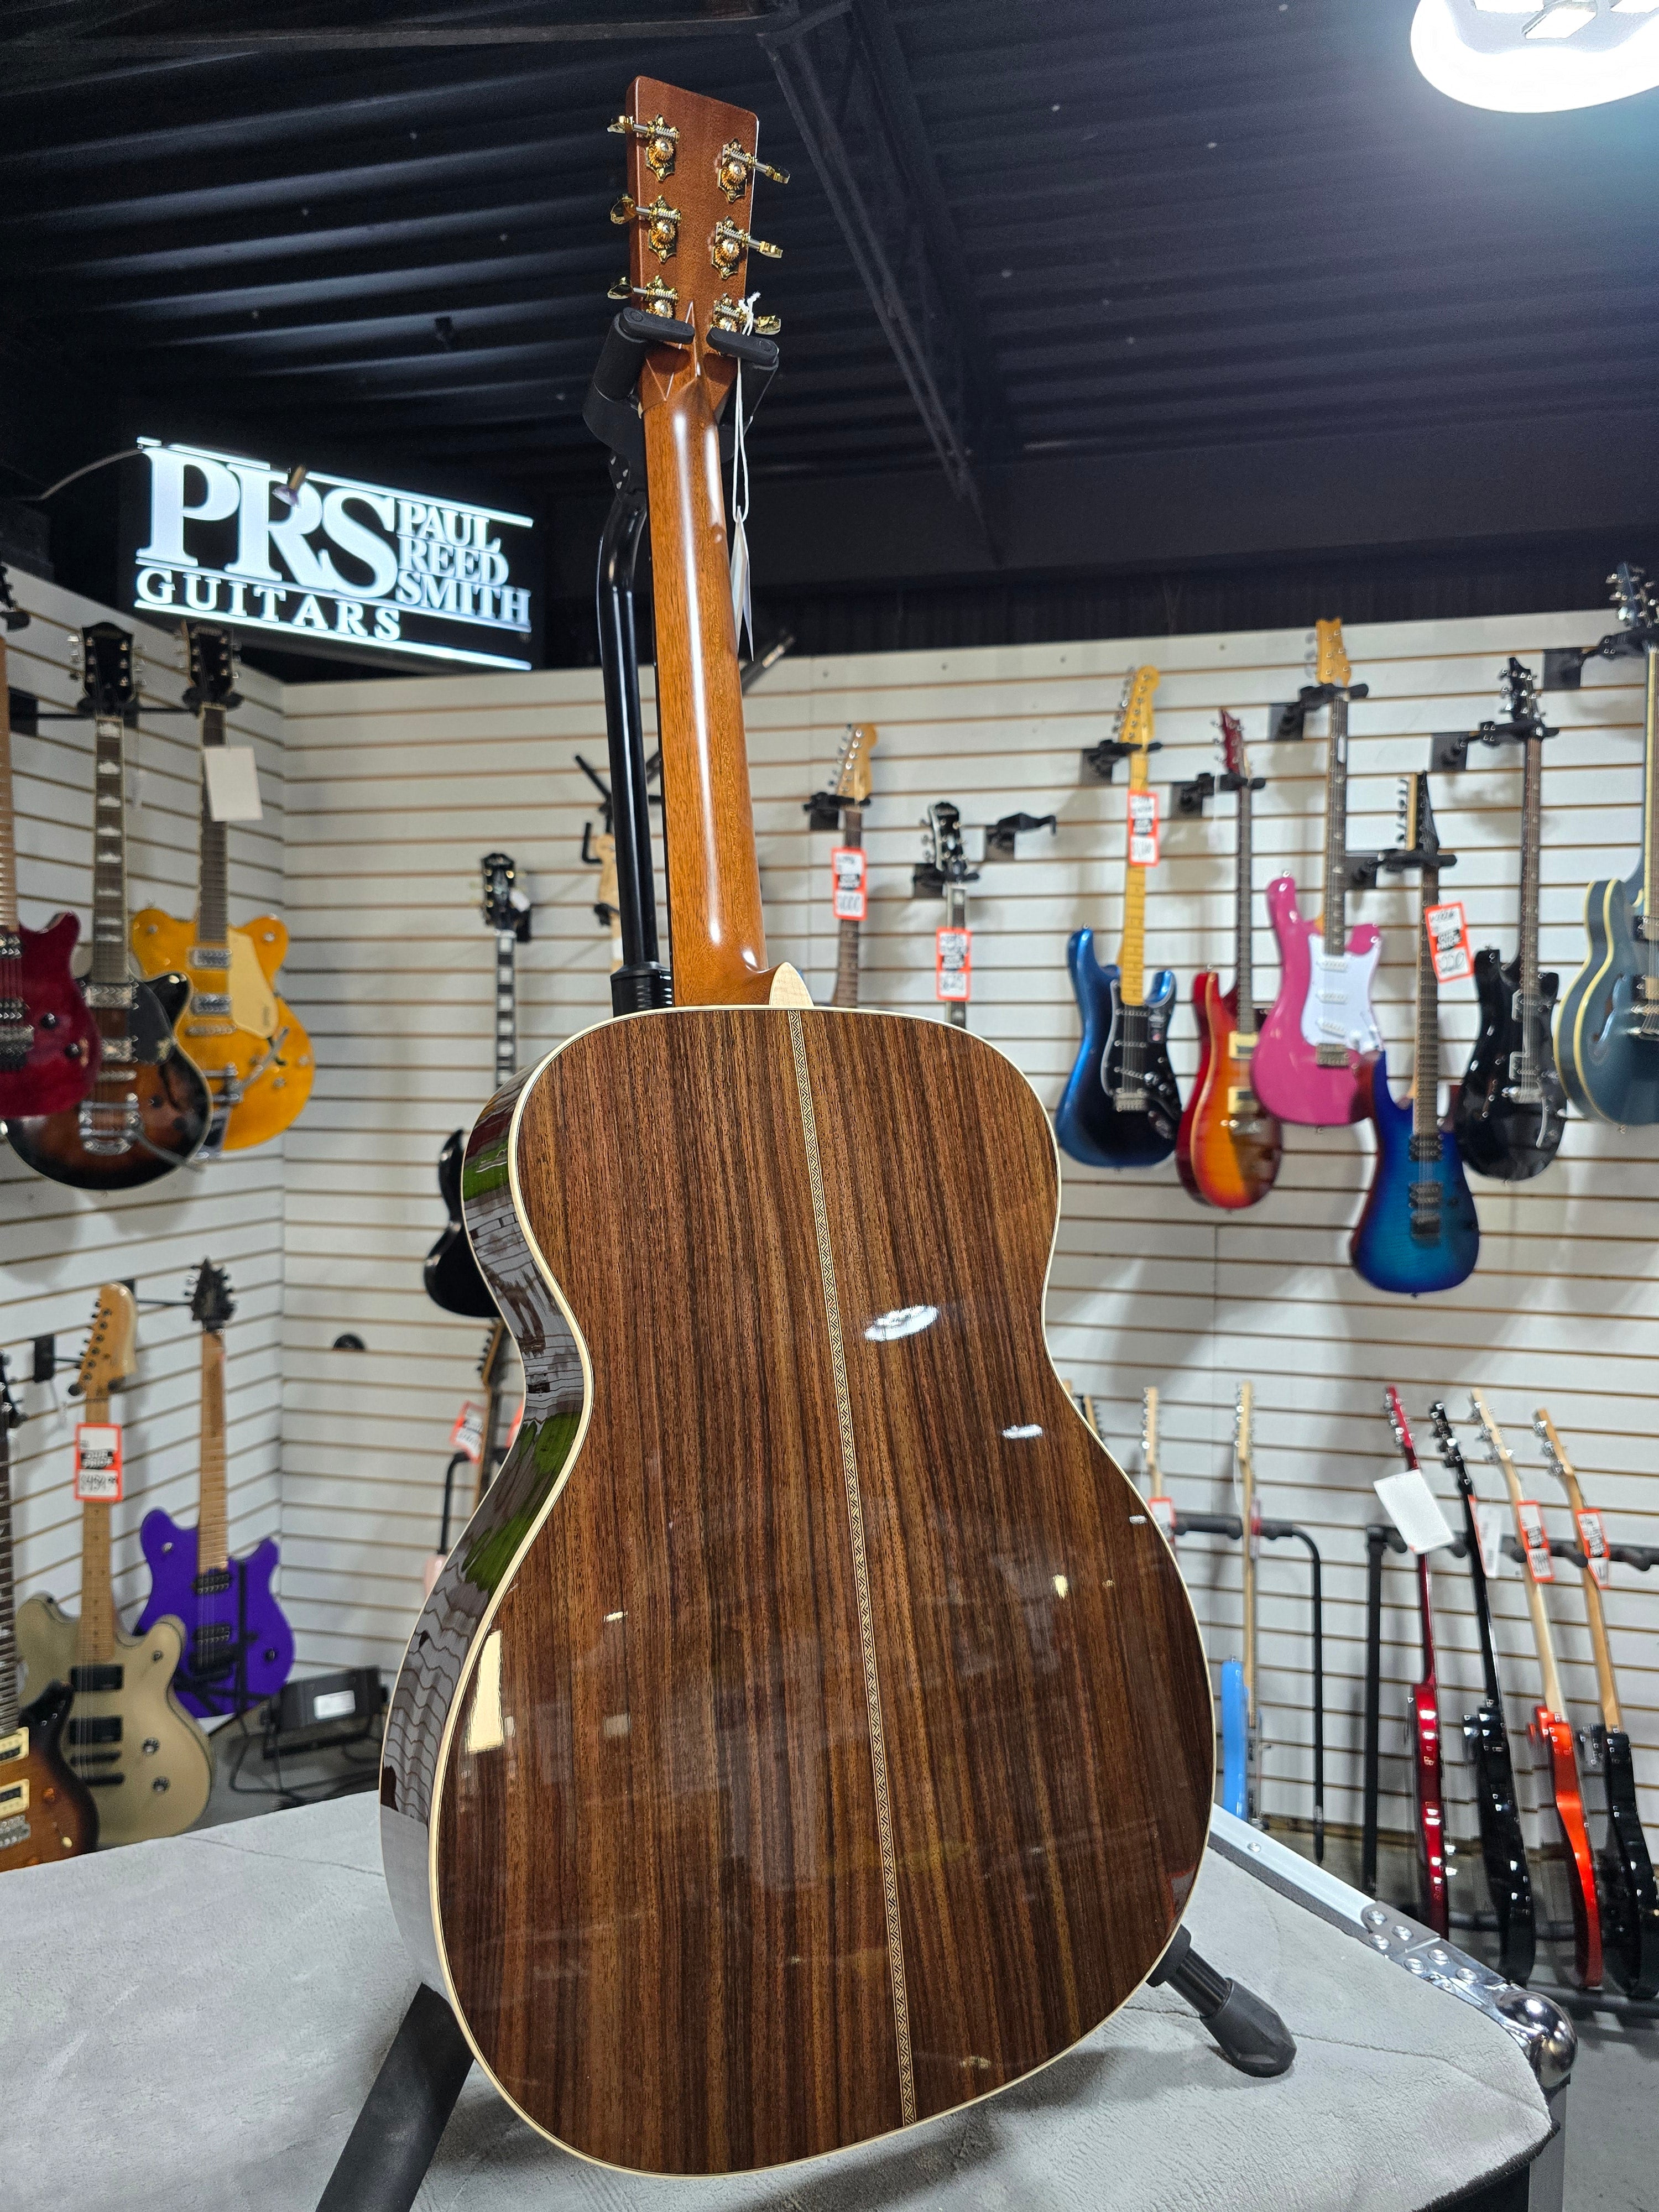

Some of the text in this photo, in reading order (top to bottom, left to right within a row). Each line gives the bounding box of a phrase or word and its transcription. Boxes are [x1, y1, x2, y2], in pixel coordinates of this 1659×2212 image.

[136, 447, 399, 598] PRS
[398, 499, 501, 554] PAUL
[398, 534, 509, 587] REED
[136, 567, 401, 641] GUITARS
[397, 570, 532, 626] SMITH
